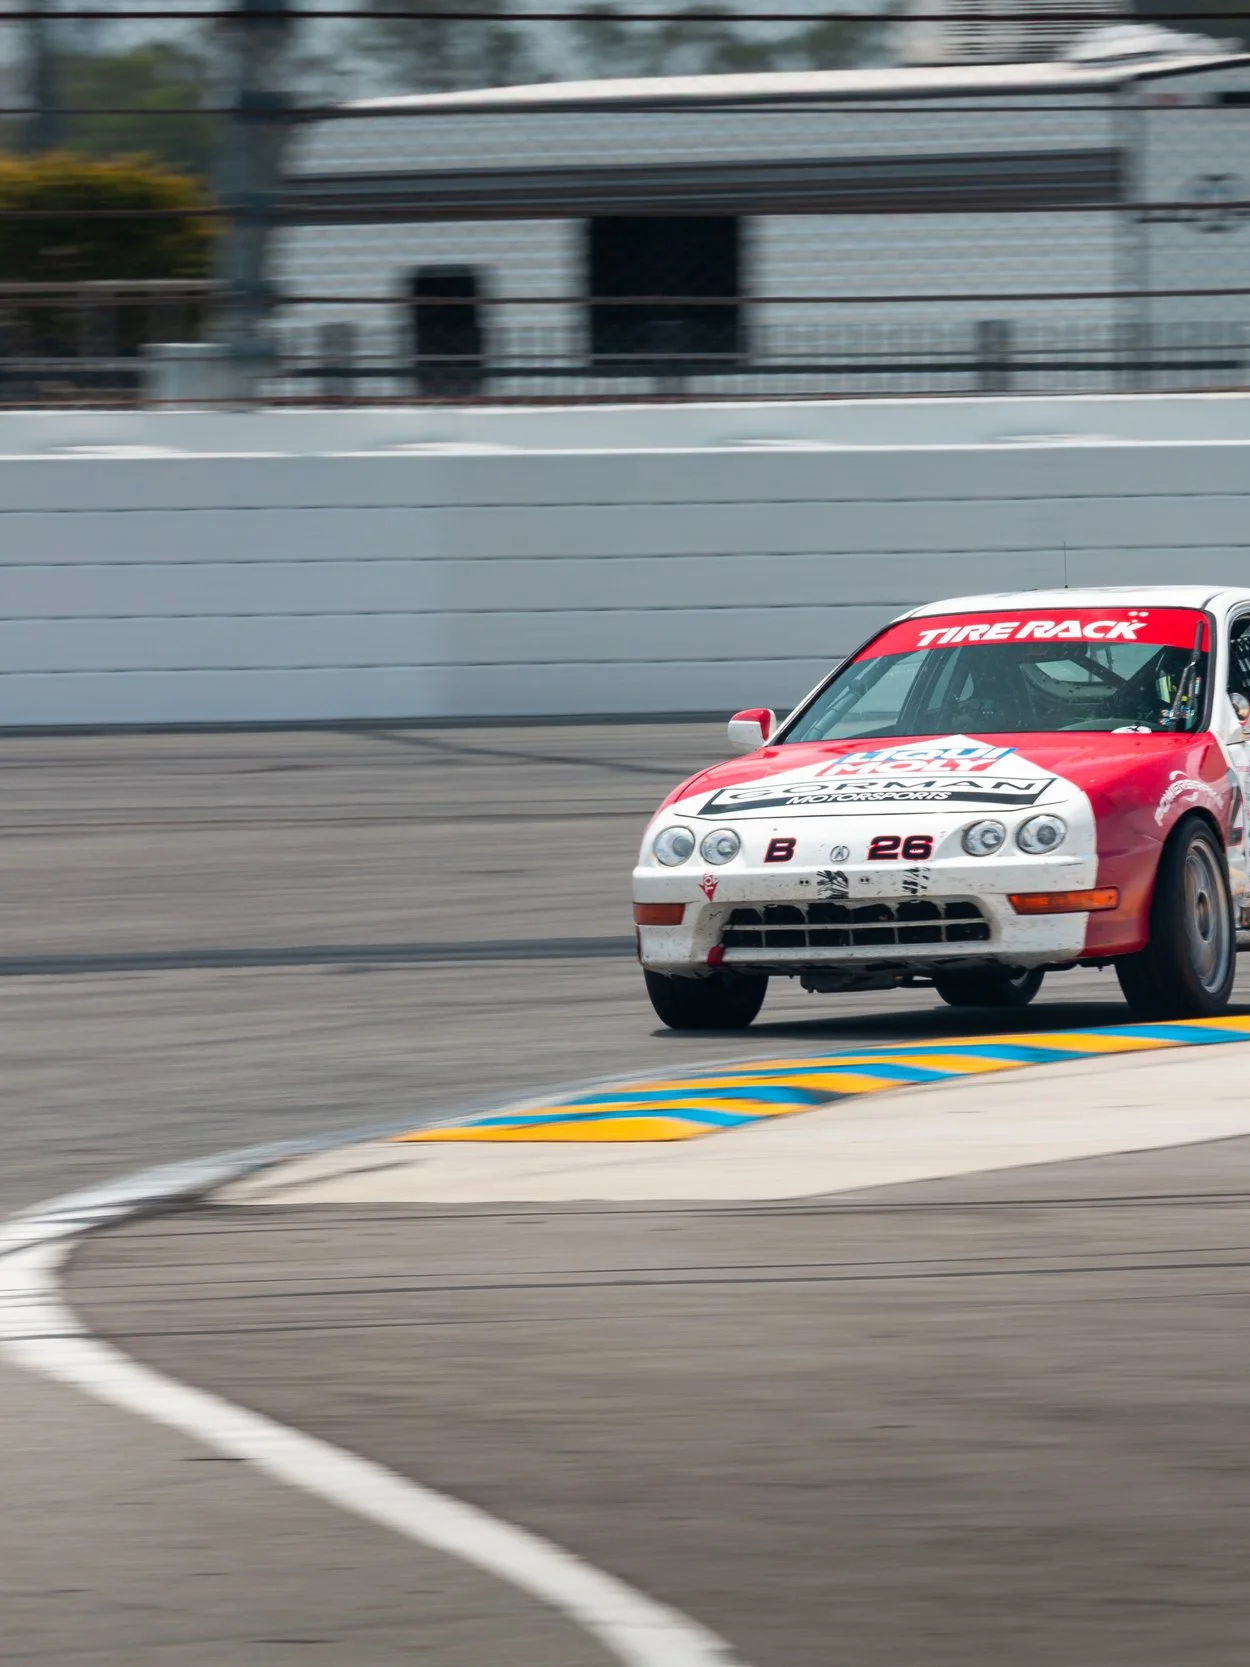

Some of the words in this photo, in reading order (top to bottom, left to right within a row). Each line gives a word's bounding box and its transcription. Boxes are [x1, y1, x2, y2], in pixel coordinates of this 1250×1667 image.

[916, 621, 1015, 647] TIRE
[1014, 620, 1148, 640] RACK
[821, 758, 990, 776] MOLY
[840, 747, 1012, 763] LIQUI
[728, 778, 1036, 802] GORMAN
[785, 791, 952, 806] MOTORSPORTS
[764, 837, 797, 863] B
[867, 834, 934, 861] 26
